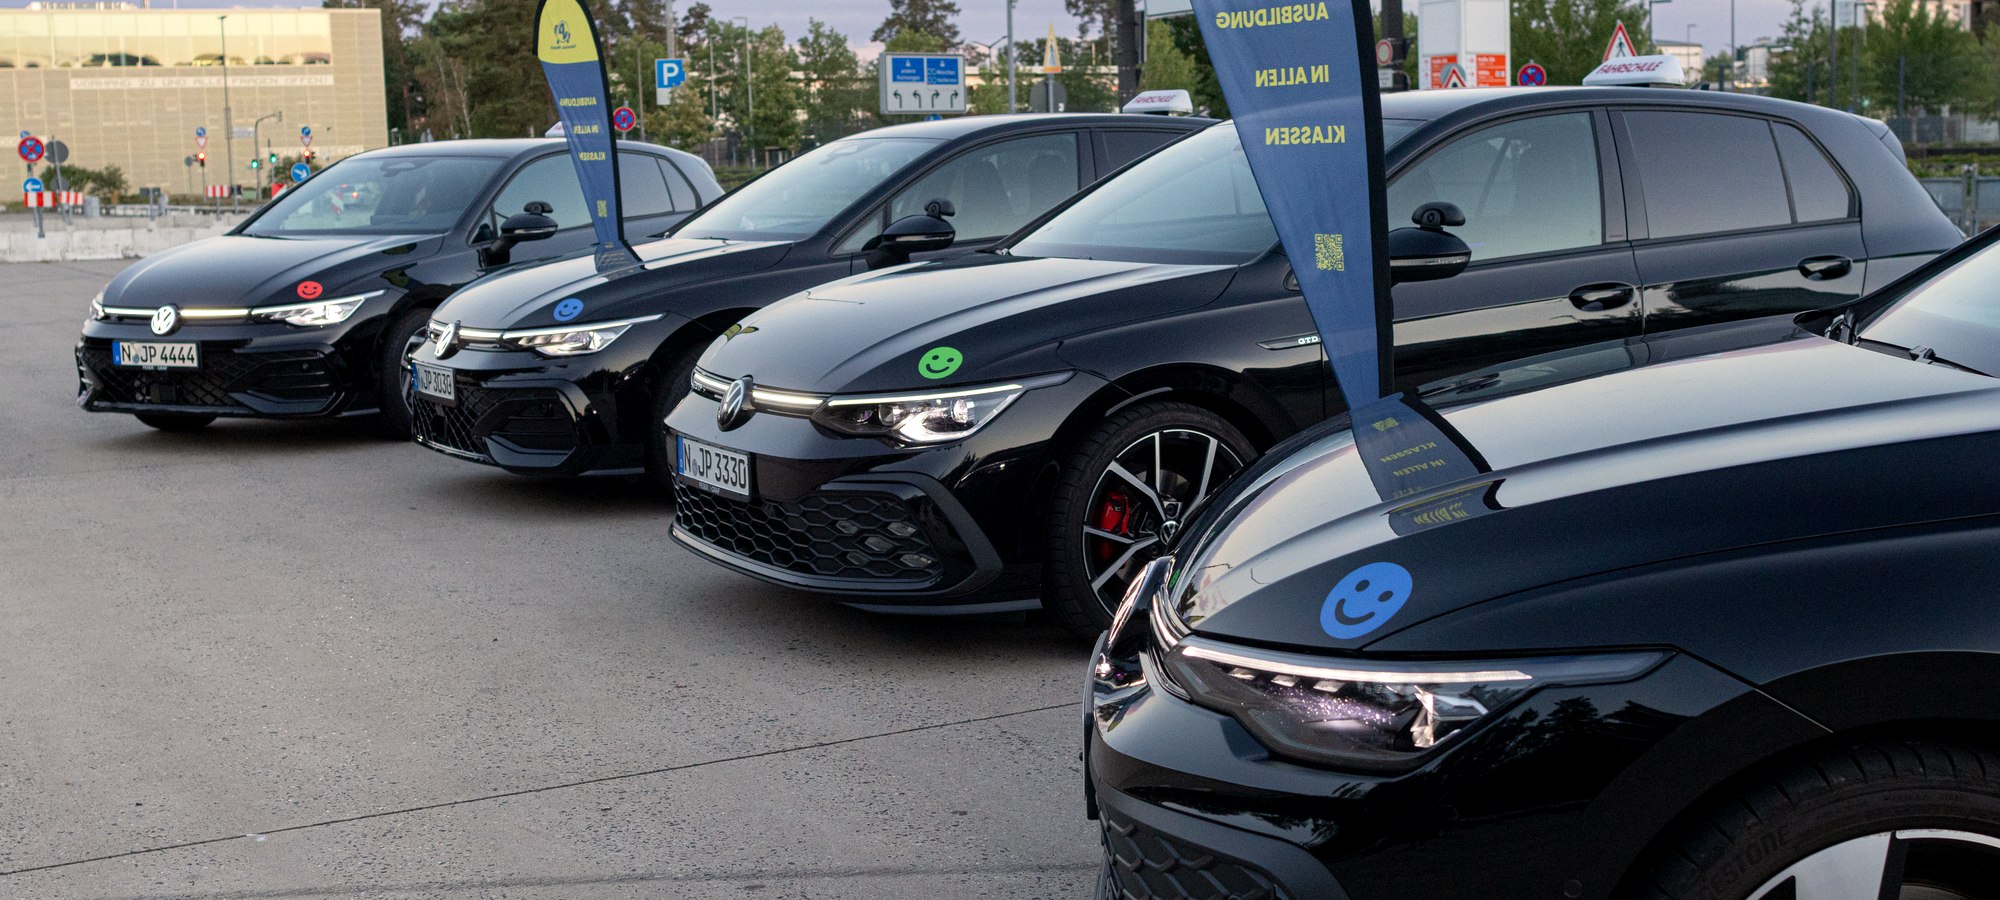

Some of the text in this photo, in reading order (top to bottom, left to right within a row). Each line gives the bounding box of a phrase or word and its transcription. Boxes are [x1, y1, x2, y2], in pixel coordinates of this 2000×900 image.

[663, 63, 679, 86] P
[1596, 61, 1663, 75] FAHRSCHULE
[1297, 336, 1319, 345] GTD
[121, 344, 195, 364] N JP 4444
[423, 369, 432, 390] JP
[1381, 441, 1437, 462] KLASSEN
[683, 442, 747, 490] N JP 3330
